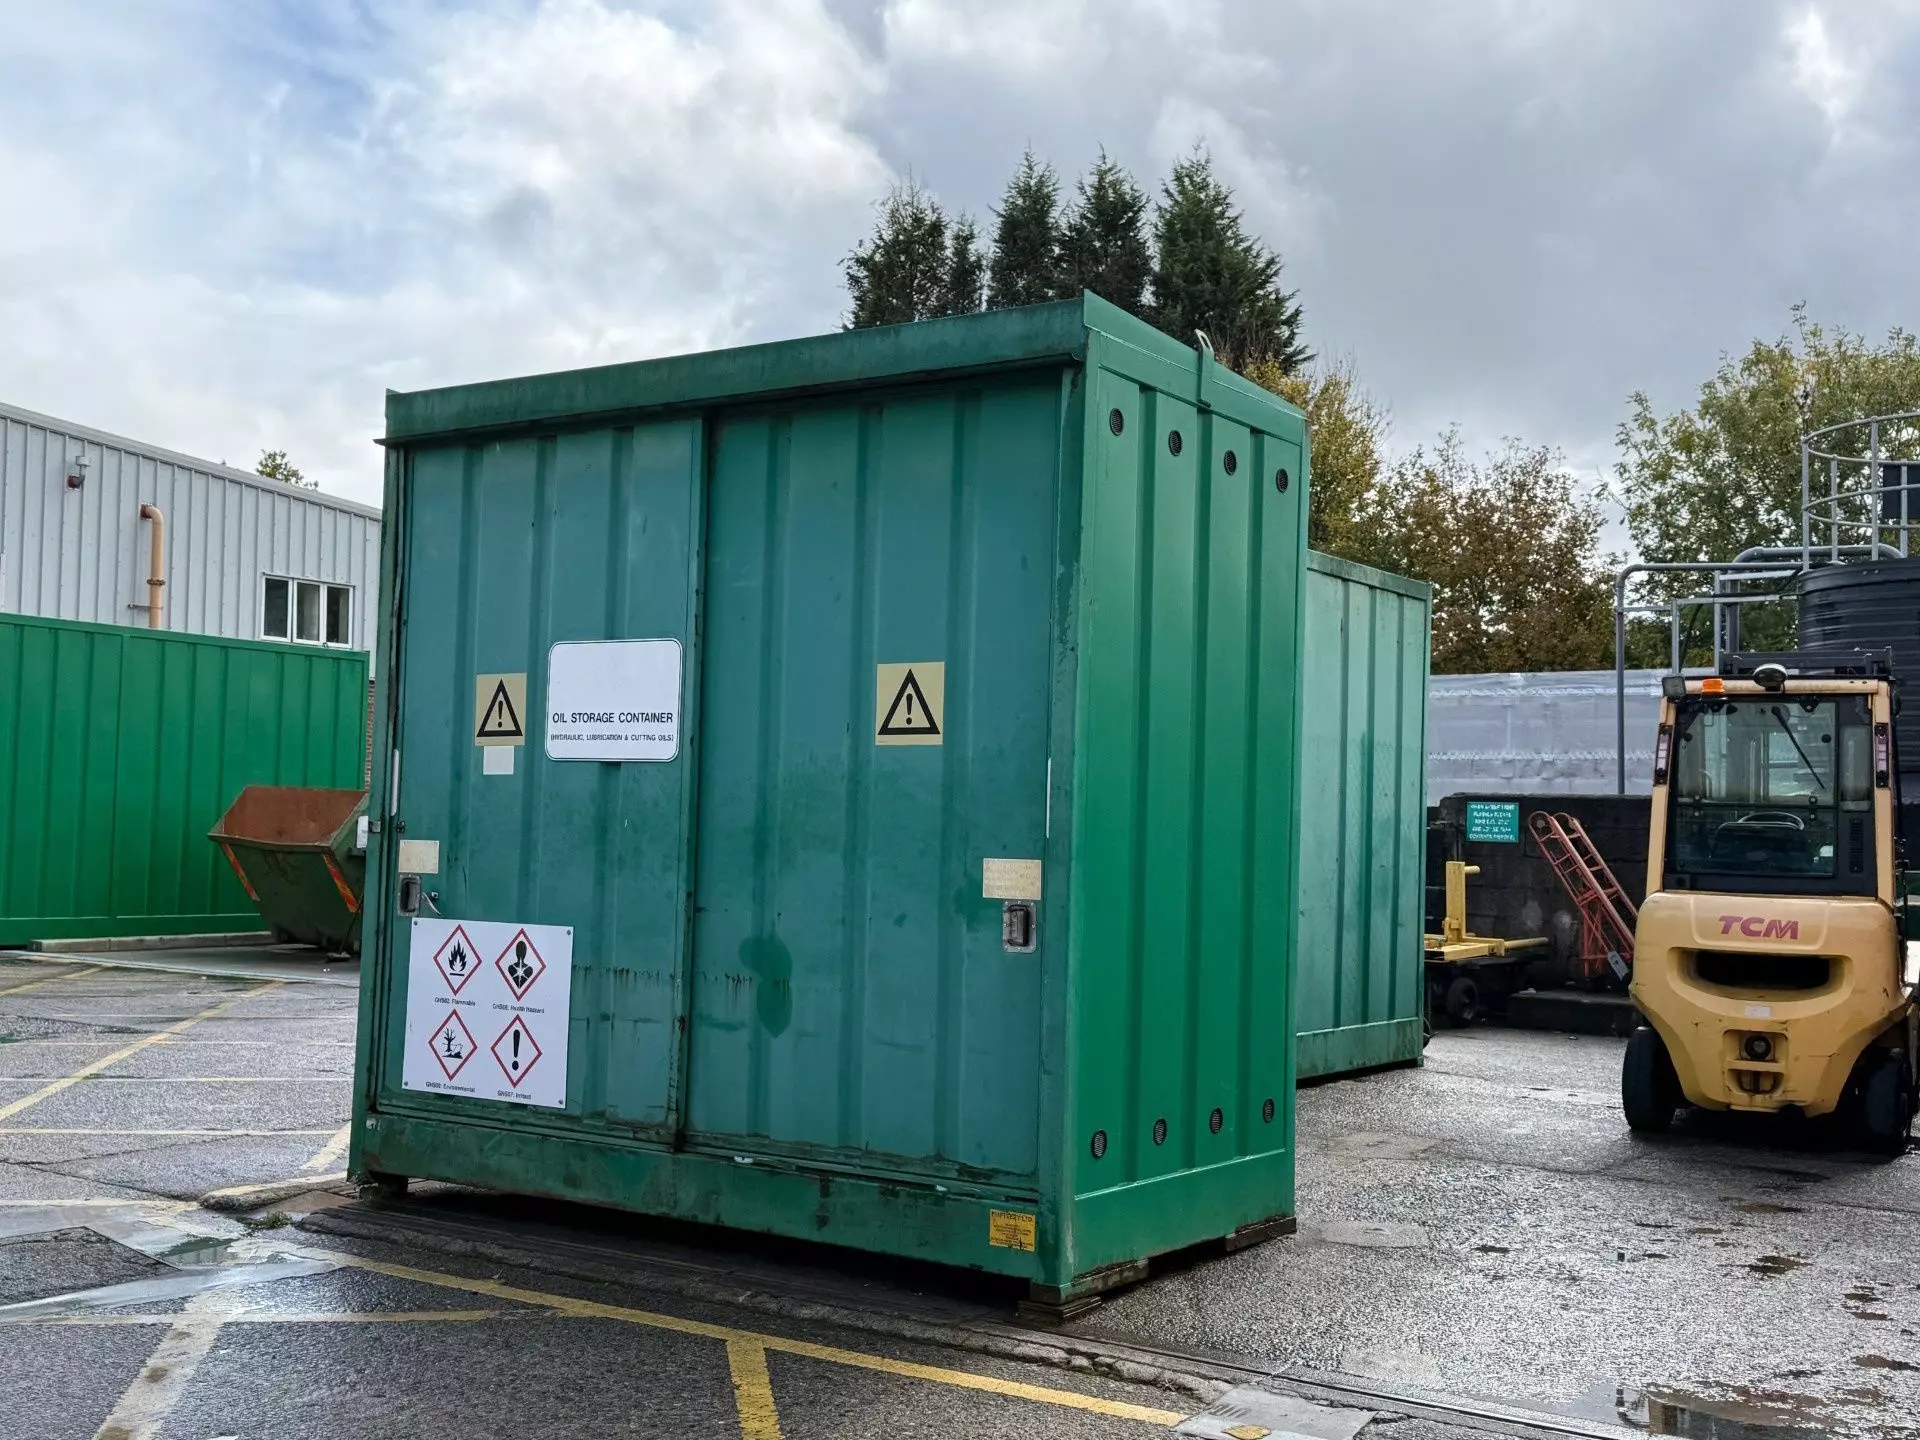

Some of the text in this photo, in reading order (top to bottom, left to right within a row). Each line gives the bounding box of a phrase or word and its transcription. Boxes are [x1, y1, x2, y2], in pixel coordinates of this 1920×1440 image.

[552, 712, 673, 723] OIL STORAGE CONTAINER
[630, 734, 656, 742] CUTTING
[1718, 915, 1799, 940] TCM
